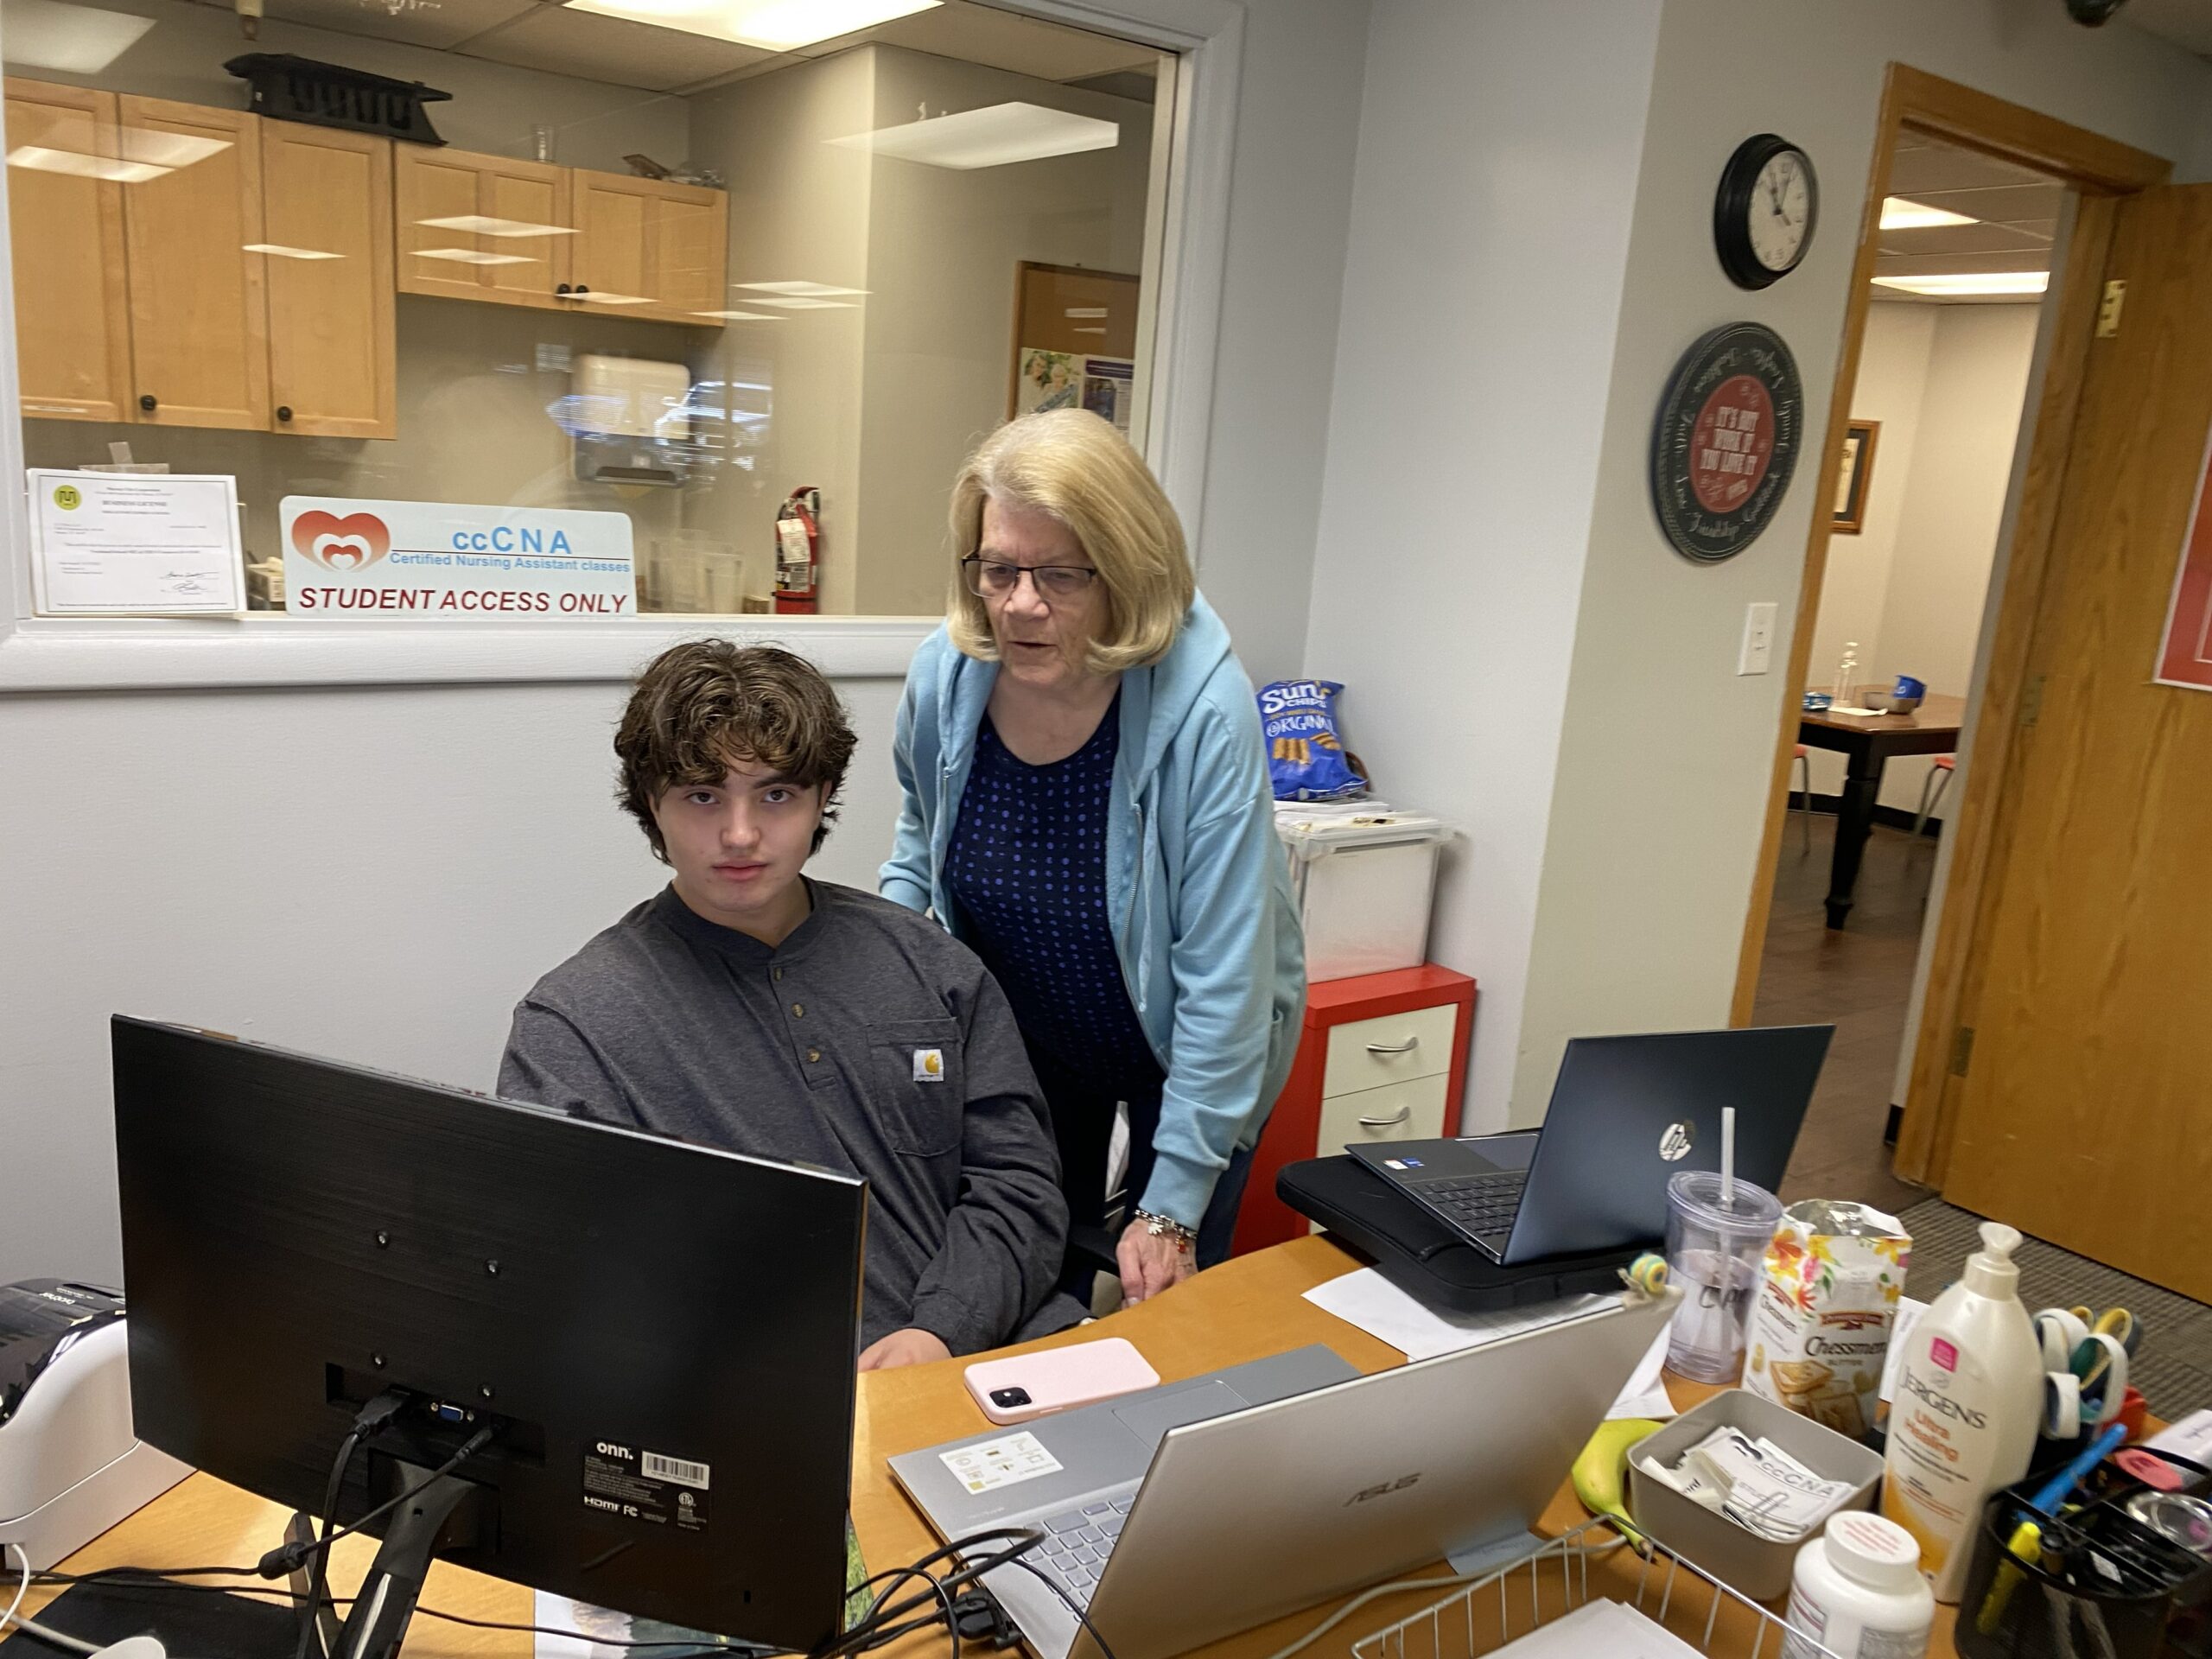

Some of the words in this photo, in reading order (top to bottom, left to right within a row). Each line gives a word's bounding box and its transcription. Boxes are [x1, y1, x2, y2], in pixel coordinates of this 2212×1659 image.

[390, 553, 452, 567] Certified
[456, 554, 512, 570] Nursing
[515, 557, 579, 571] Assistant
[582, 560, 631, 573] classes
[299, 588, 435, 610] STUDENT
[440, 590, 551, 612] ACCESS
[559, 593, 628, 613] ONLY
[1262, 683, 1326, 715] Sun
[1900, 1365, 1987, 1429] JERGENS
[1904, 1417, 1959, 1463] Healing
[1914, 1408, 1950, 1440] Ultra
[1342, 1472, 1421, 1508] ASUS
